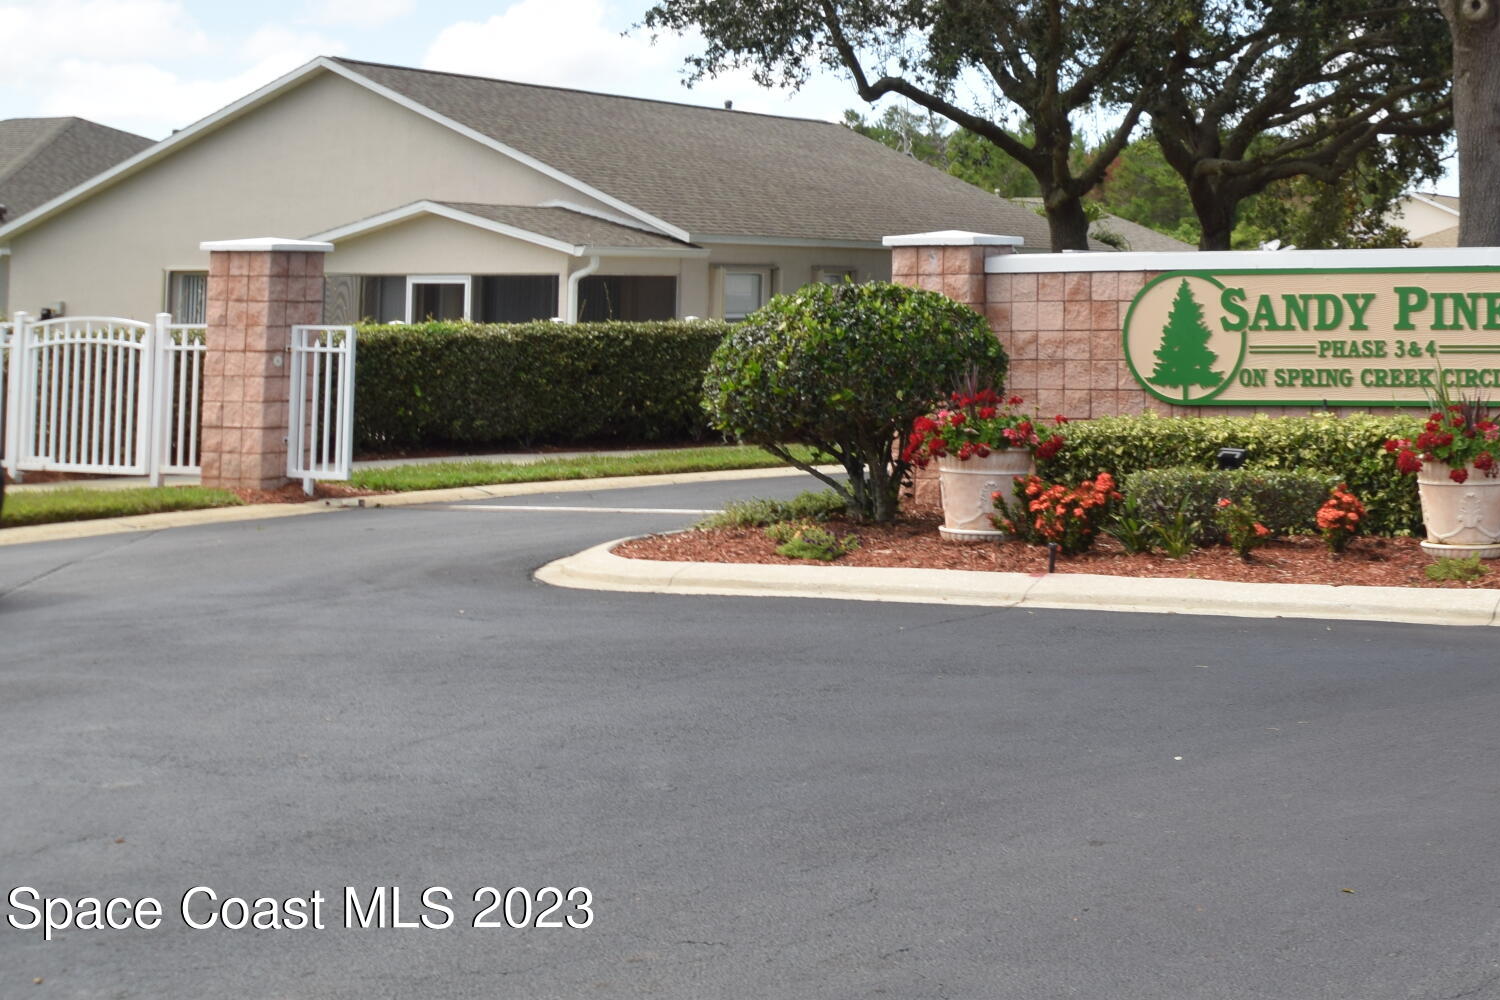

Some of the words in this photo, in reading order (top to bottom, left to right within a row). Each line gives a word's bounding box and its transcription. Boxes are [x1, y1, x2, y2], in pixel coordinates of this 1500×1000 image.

[1220, 287, 1377, 332] SANDY
[1317, 339, 1388, 358] PHASE
[1239, 368, 1268, 388] ON
[1274, 368, 1354, 388] SPRING
[1360, 368, 1436, 388] CREEK
